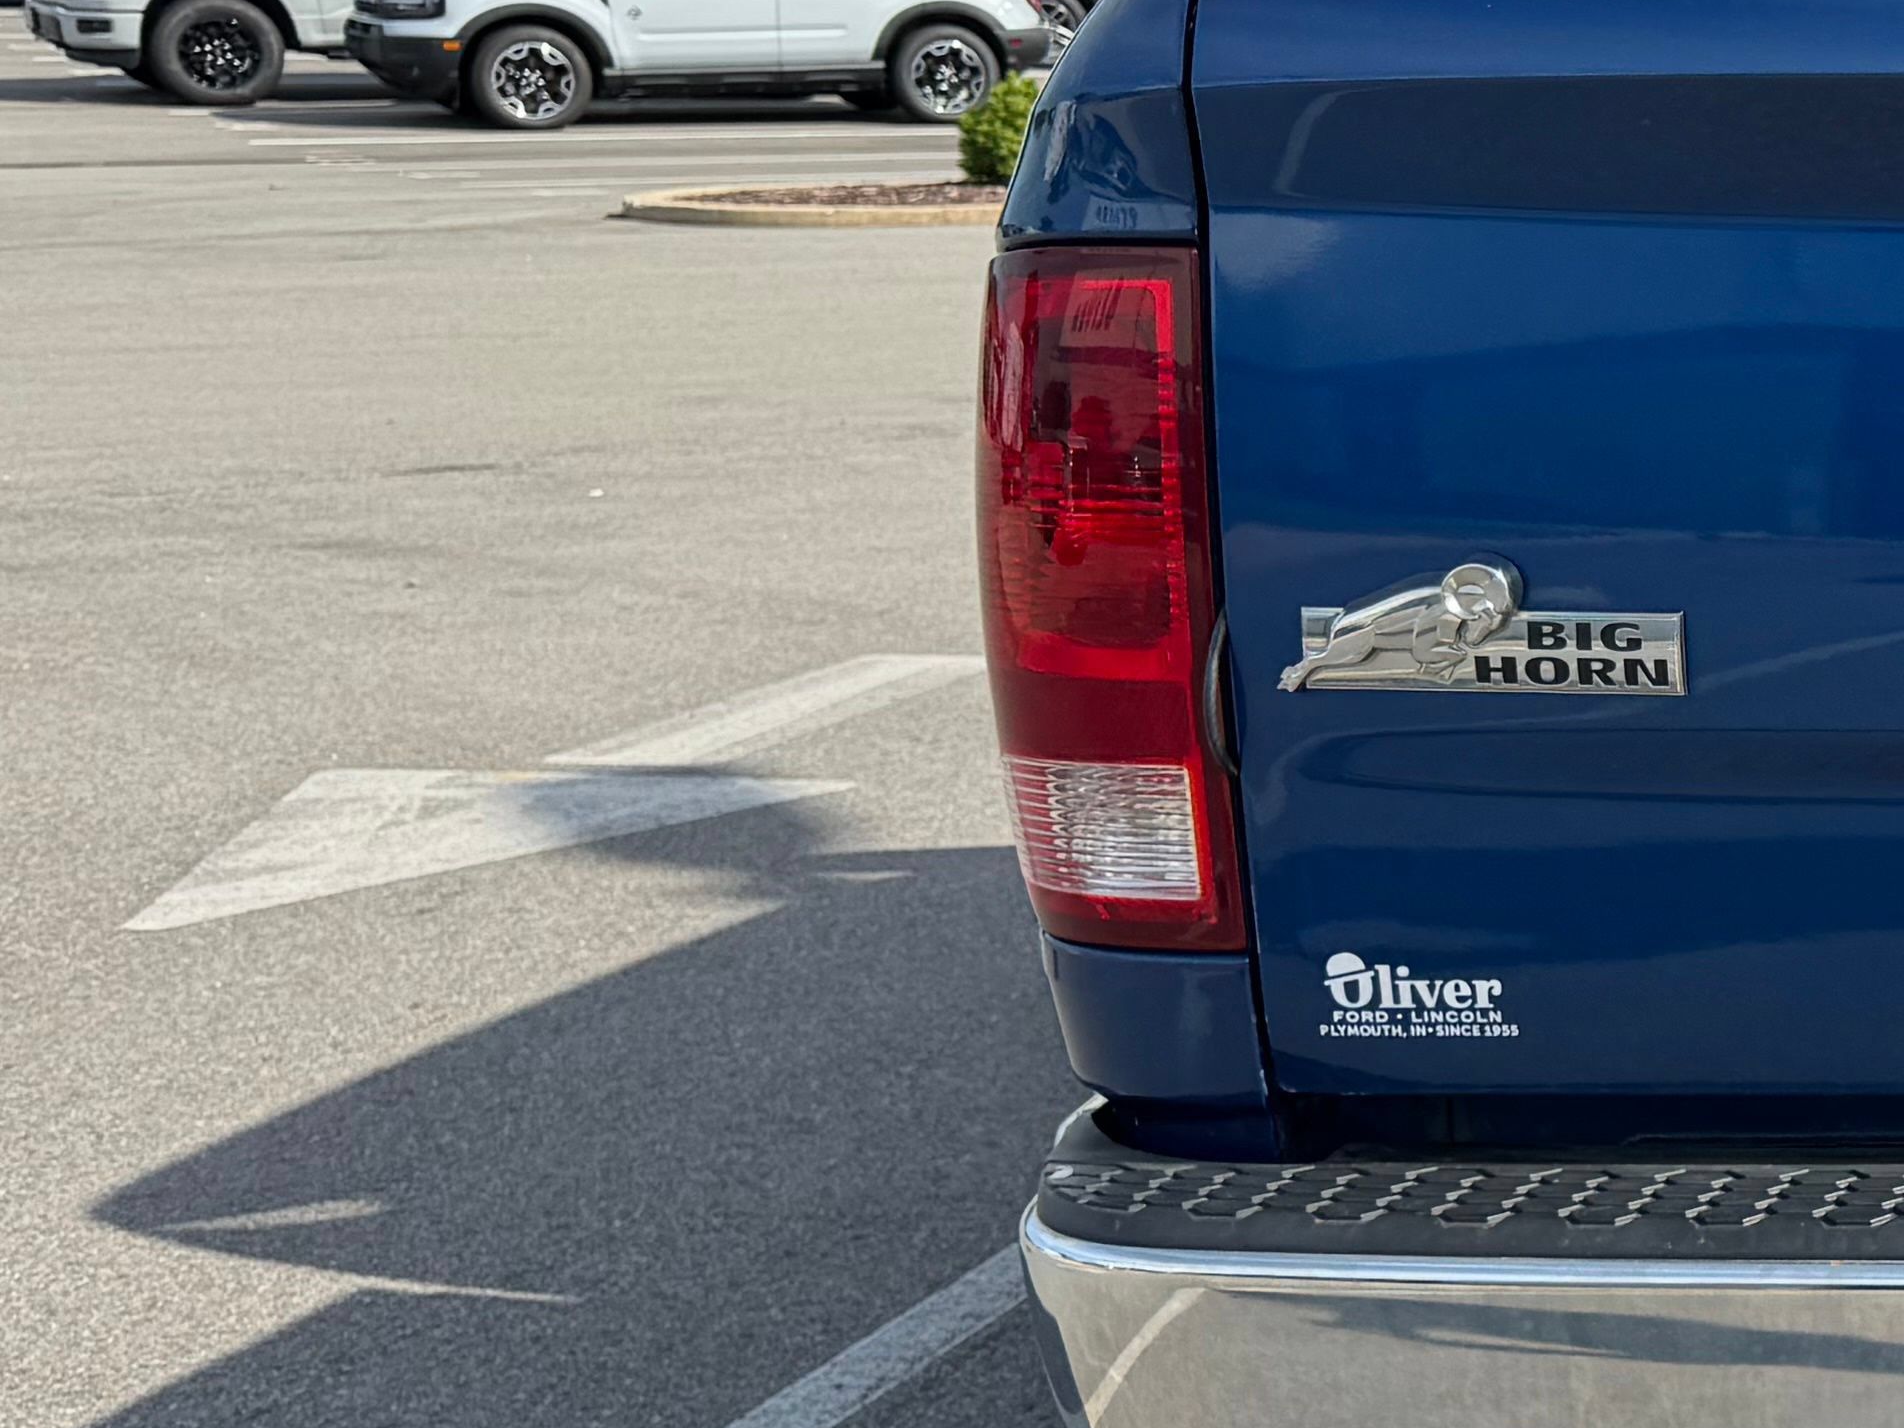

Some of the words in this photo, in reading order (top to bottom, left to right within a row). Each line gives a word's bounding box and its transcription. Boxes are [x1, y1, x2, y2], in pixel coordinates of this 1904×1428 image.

[1526, 621, 1643, 652] BIG
[1475, 656, 1670, 688] HORN
[1324, 952, 1502, 1009] Oliver
[1319, 1025, 1407, 1038] PLYMOUTH,
[1484, 1025, 1520, 1037] 1955
[1333, 1011, 1389, 1023] FORD
[1411, 1011, 1503, 1023] LINCOLN
